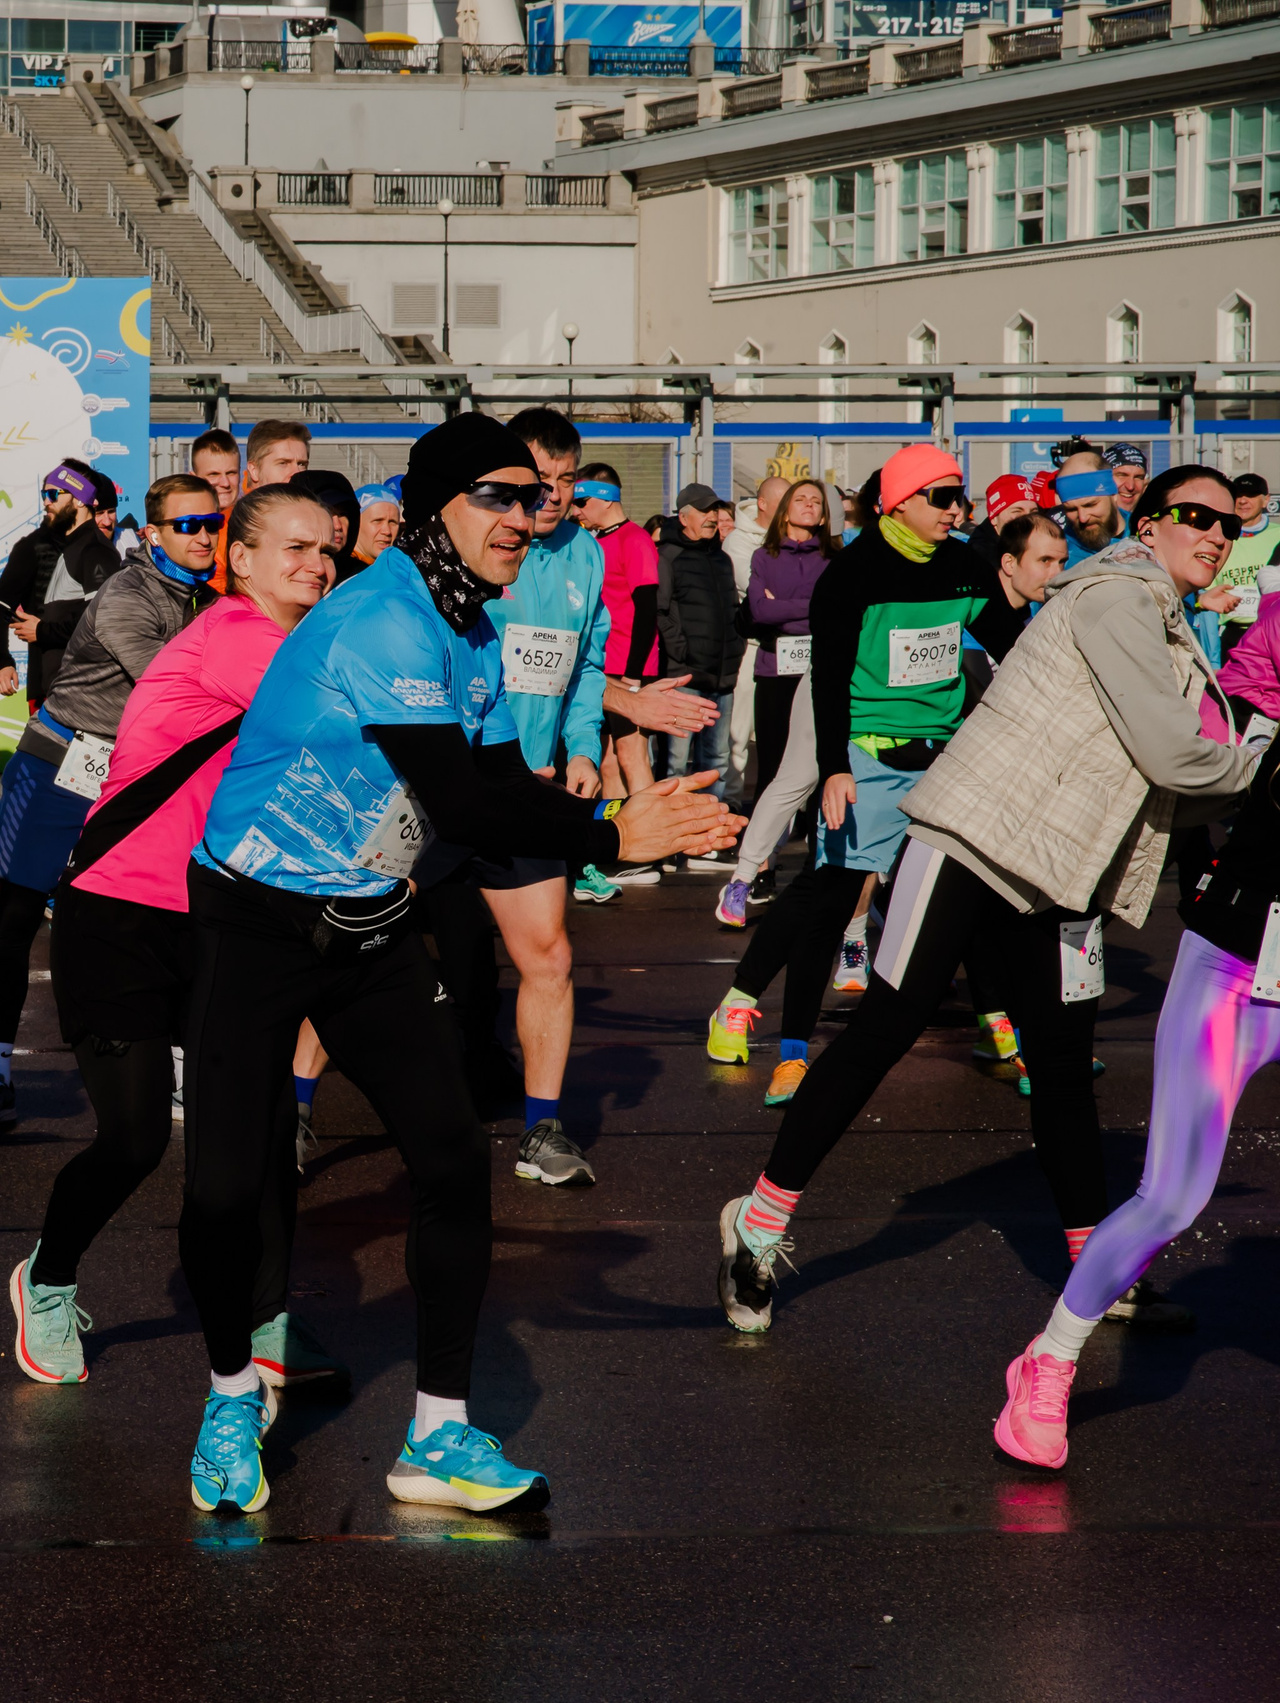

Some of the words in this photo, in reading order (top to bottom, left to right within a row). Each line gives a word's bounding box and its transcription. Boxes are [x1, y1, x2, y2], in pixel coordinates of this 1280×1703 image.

[22, 55, 53, 70] VIP
[34, 75, 59, 87] SKY
[1233, 574, 1258, 586] БЕГУ
[532, 631, 558, 641] АРЕНА
[918, 630, 941, 639] АРЕНА
[522, 648, 563, 669] 6527
[790, 648, 811, 659] 682
[909, 643, 947, 663] 6907
[524, 666, 558, 675] ВЛАДИМИР
[907, 660, 943, 670] АТЛАНТ
